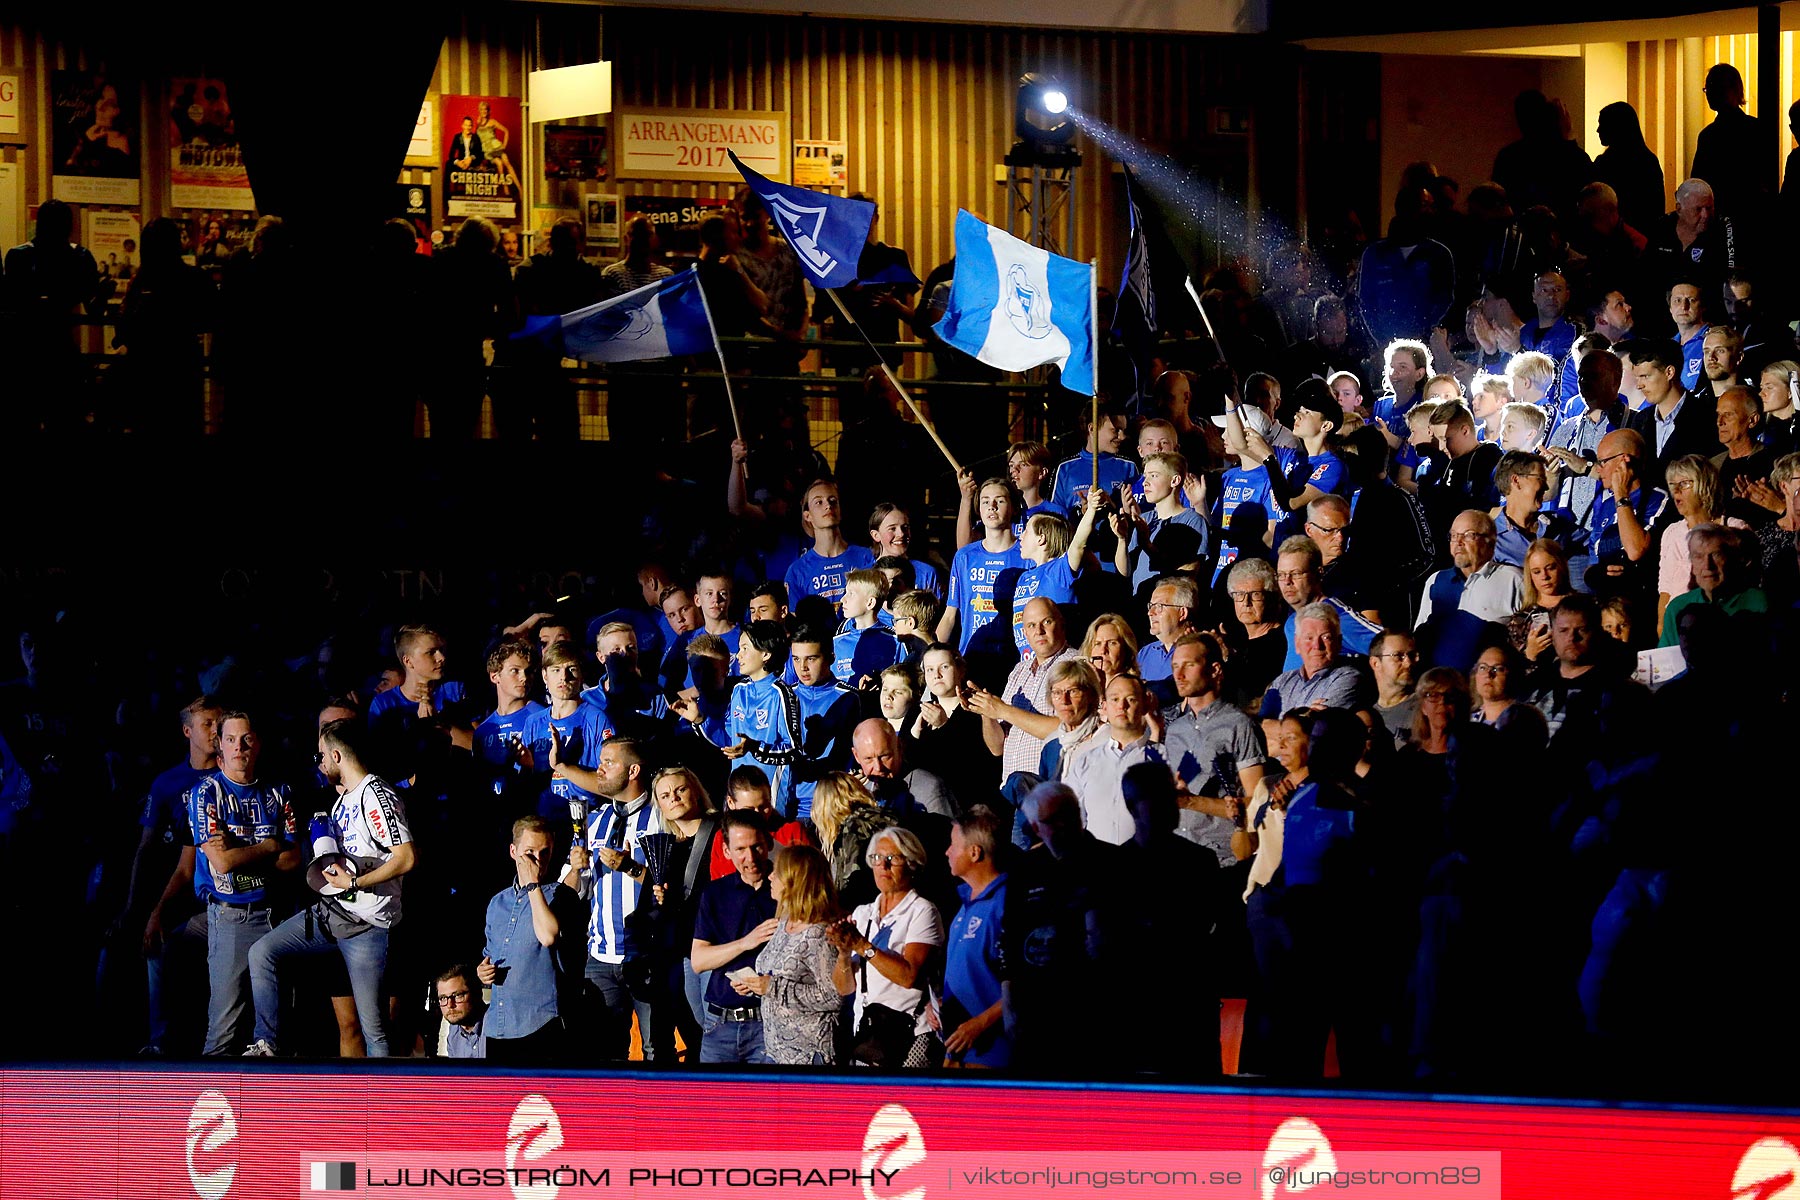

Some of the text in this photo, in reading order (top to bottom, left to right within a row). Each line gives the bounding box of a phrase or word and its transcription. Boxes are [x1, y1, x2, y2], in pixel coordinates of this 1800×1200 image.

[628, 121, 775, 144] ARRANGEMANG
[676, 146, 727, 168] 2017
[450, 171, 513, 185] CHRISTMAS
[464, 184, 499, 196] NIGHT
[634, 209, 679, 225] rena
[812, 574, 829, 590] 32
[970, 568, 986, 581] 39
